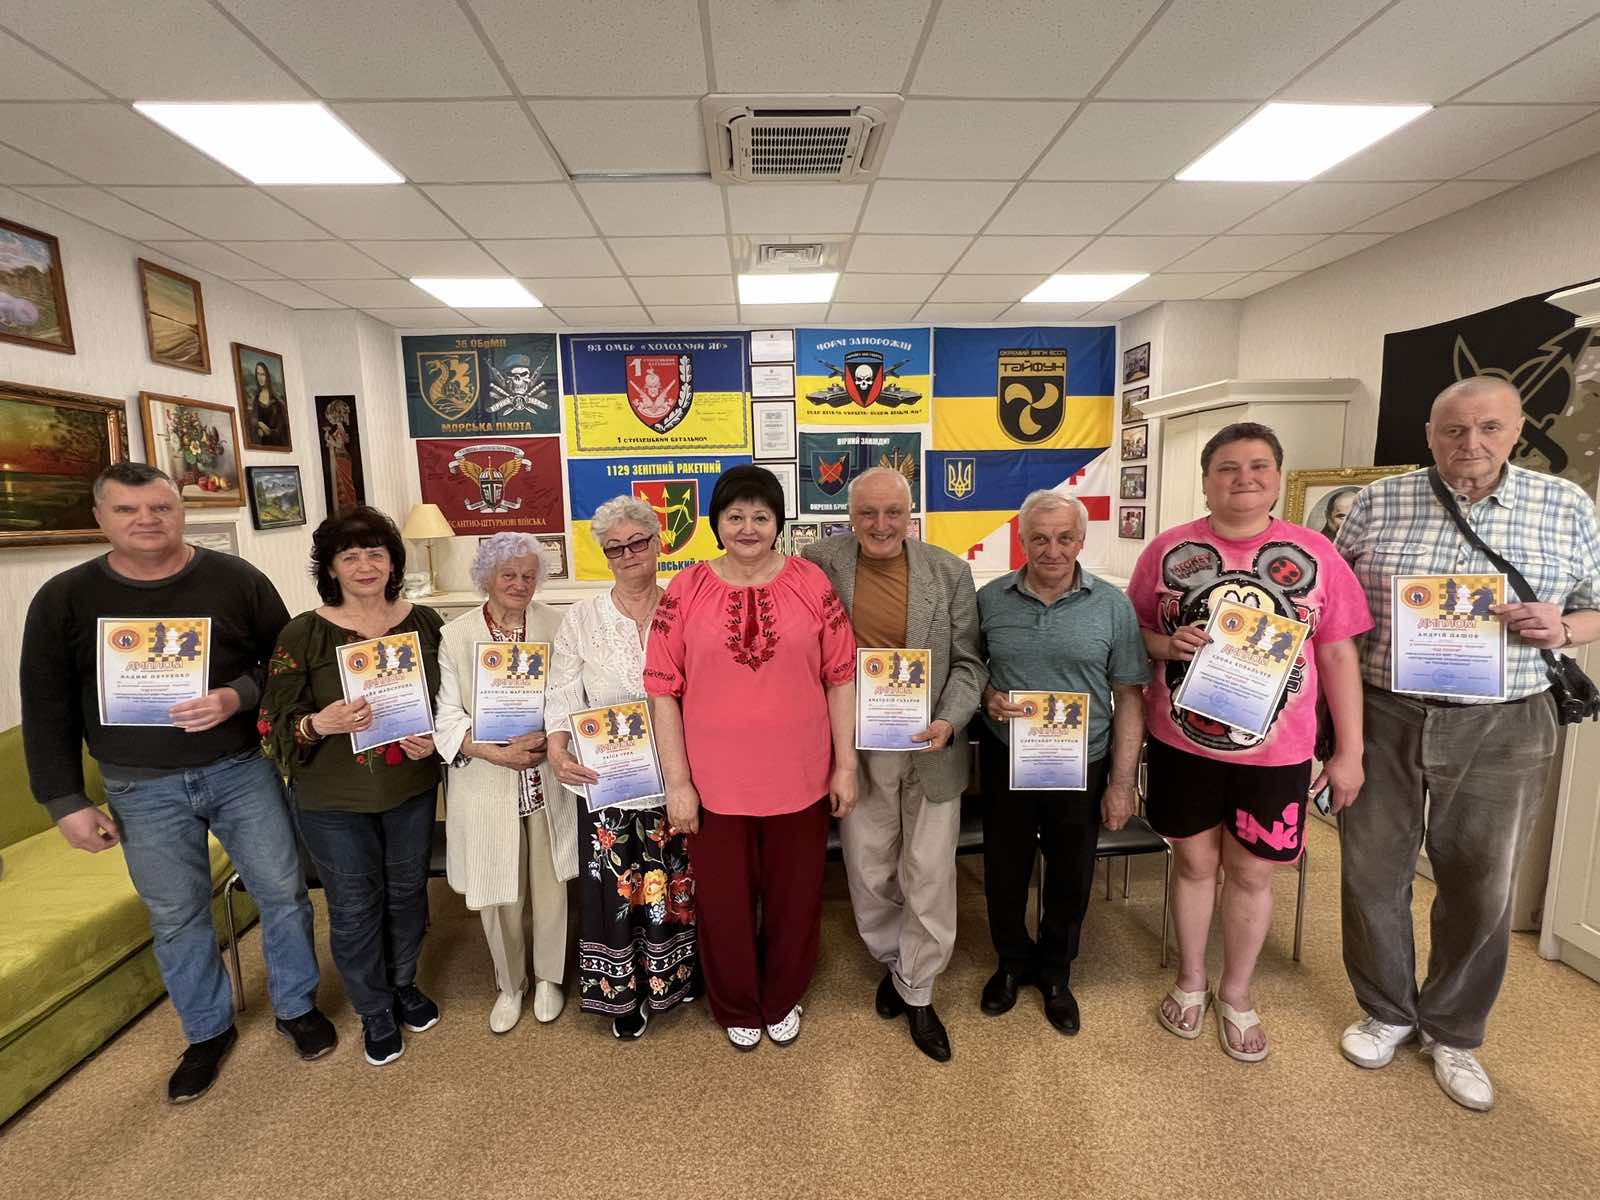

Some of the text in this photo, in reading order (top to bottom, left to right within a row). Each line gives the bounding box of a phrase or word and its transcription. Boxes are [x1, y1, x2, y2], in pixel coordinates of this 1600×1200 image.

[587, 344, 602, 352] 93
[628, 358, 642, 377] 1
[442, 421, 532, 432] МОРСЬКА ПІХОТА
[607, 460, 722, 477] 1129 ЗЕНІТНИЙ РАКЕТНИЙ
[834, 503, 848, 511] БРИГ
[448, 518, 517, 529] САНТНО-ШТУРМОВІ
[1417, 617, 1478, 630] ДИПЛОМ
